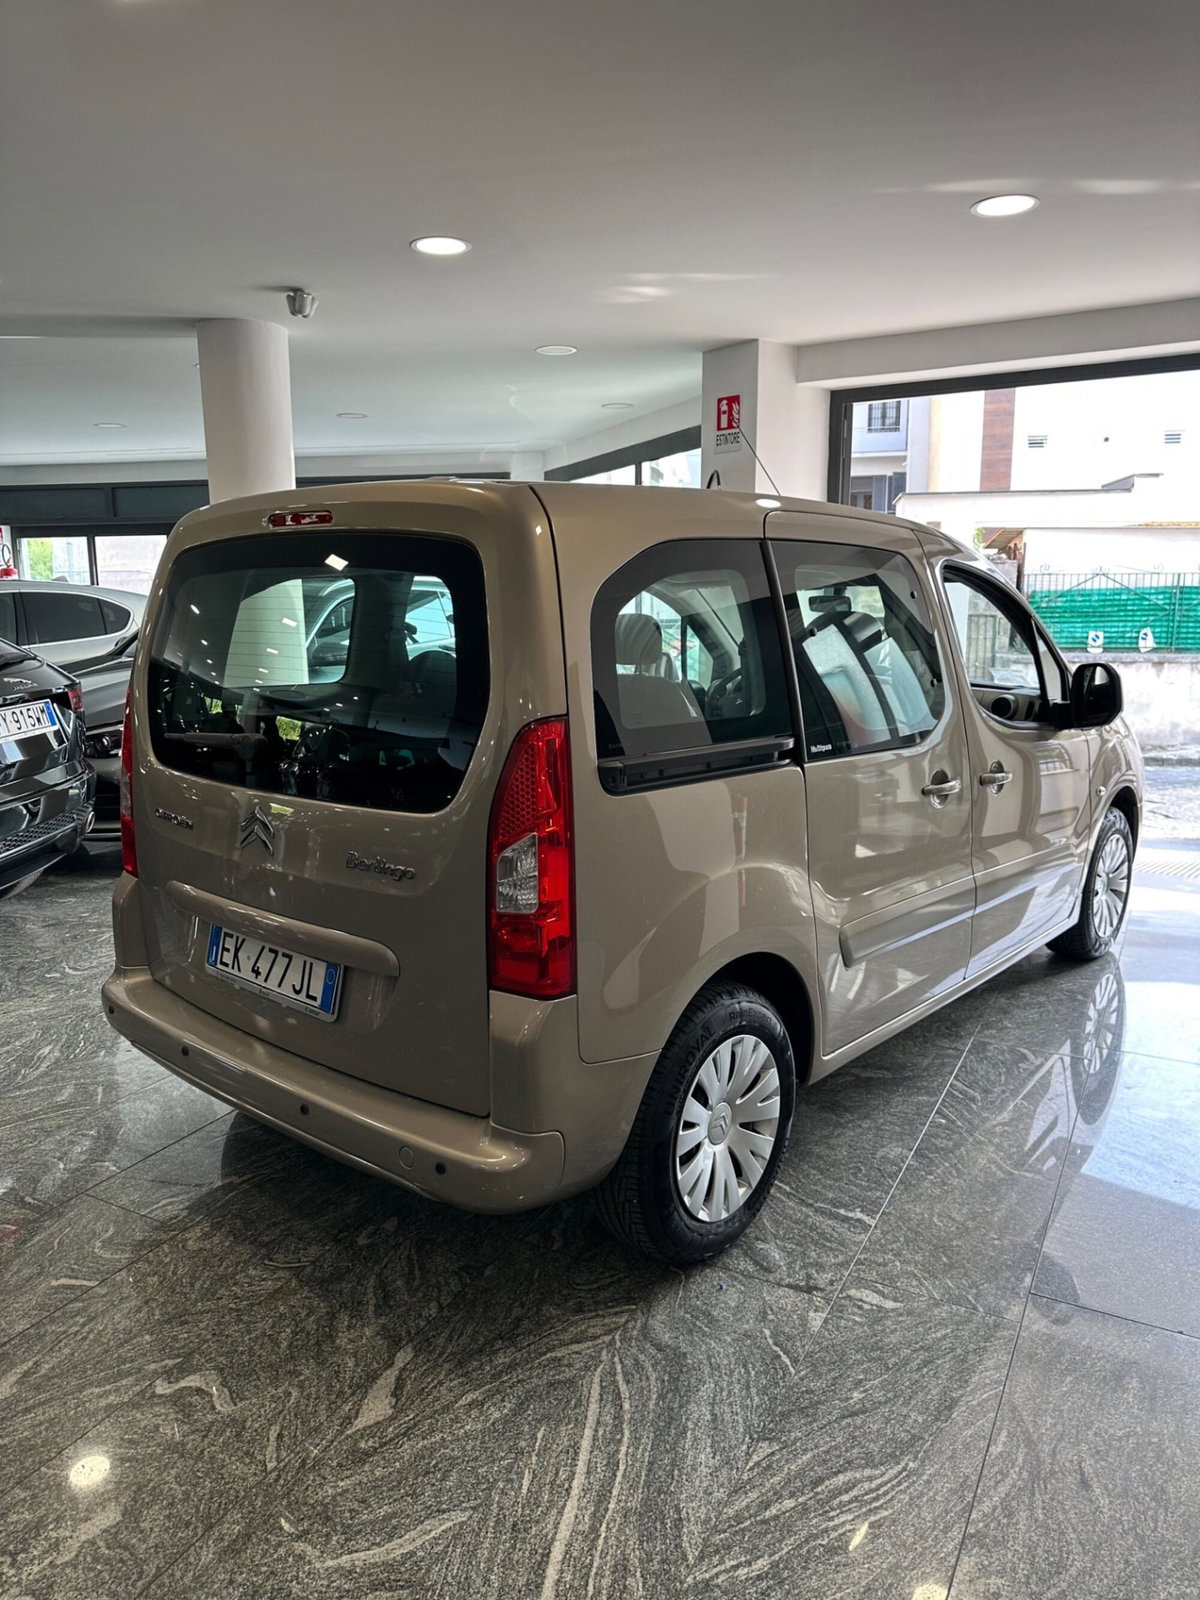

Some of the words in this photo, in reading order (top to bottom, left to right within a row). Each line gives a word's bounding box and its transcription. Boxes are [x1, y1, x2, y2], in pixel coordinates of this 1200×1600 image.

[716, 432, 740, 446] ESTINTORE
[346, 851, 416, 881] Berlingo
[219, 931, 246, 973] EK
[666, 1026, 717, 1116] UNIROYAL
